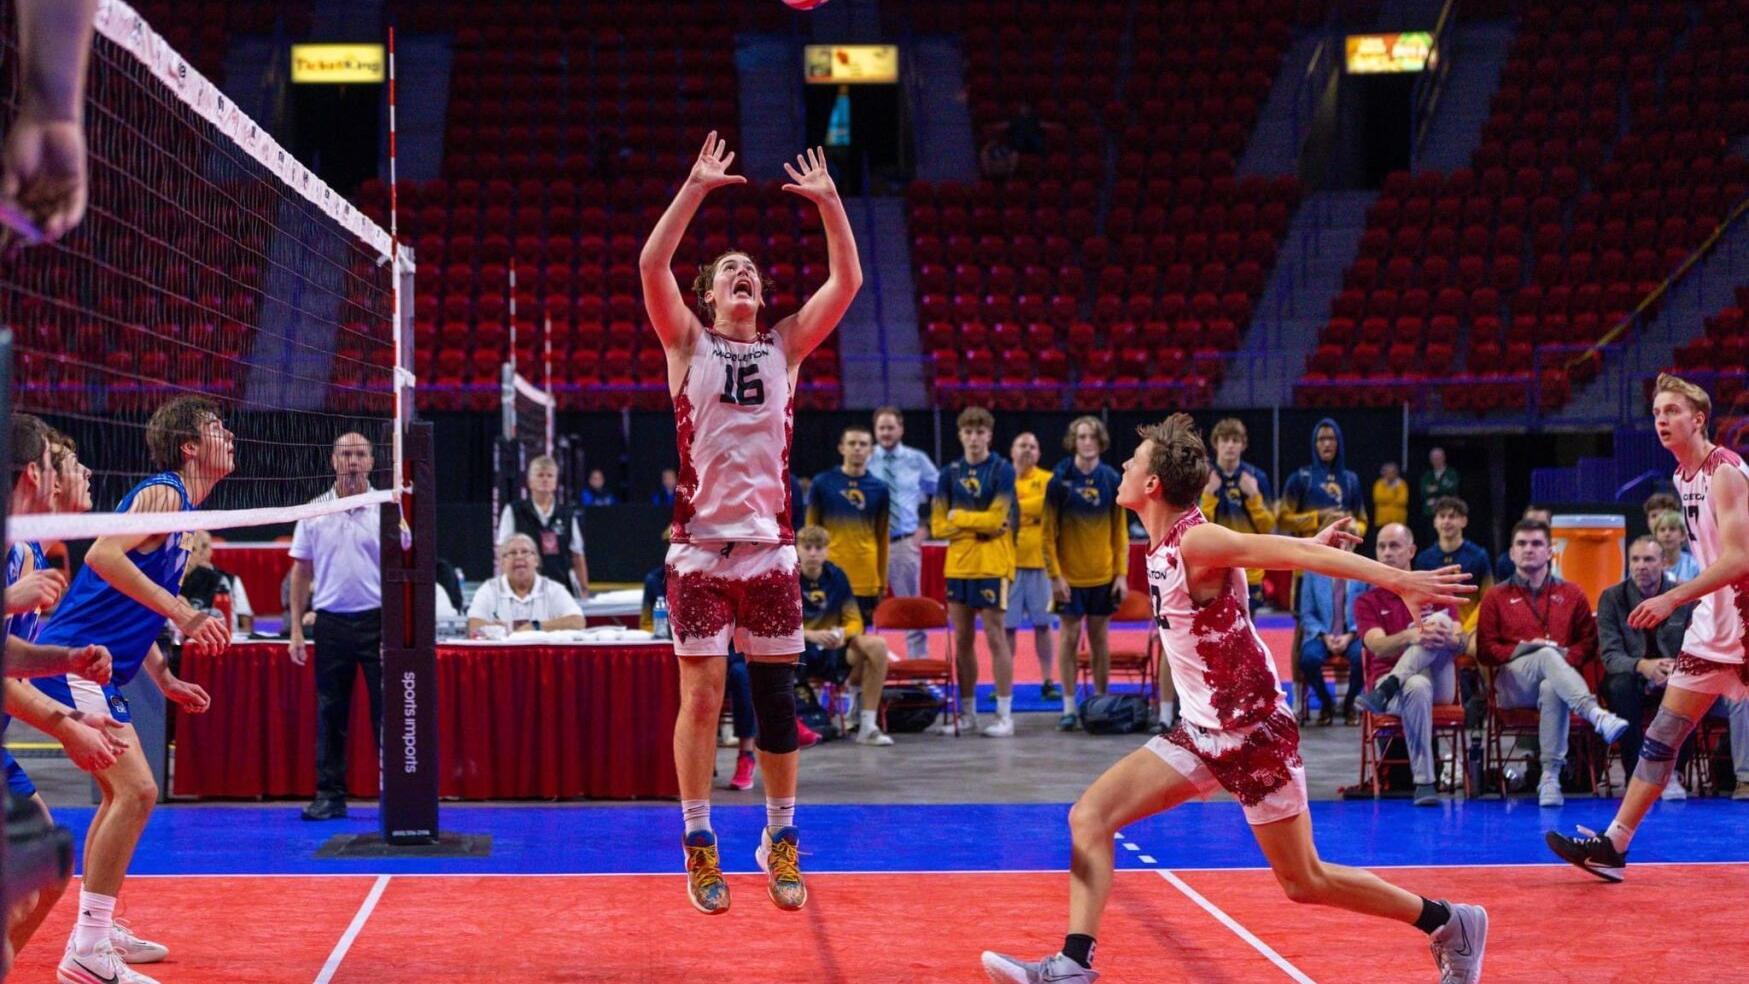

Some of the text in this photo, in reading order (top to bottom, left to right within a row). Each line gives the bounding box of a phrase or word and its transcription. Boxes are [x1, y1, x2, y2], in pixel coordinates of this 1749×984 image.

[719, 363, 765, 405] 16
[1148, 570, 1167, 580] TON
[402, 672, 418, 773] sports imports
